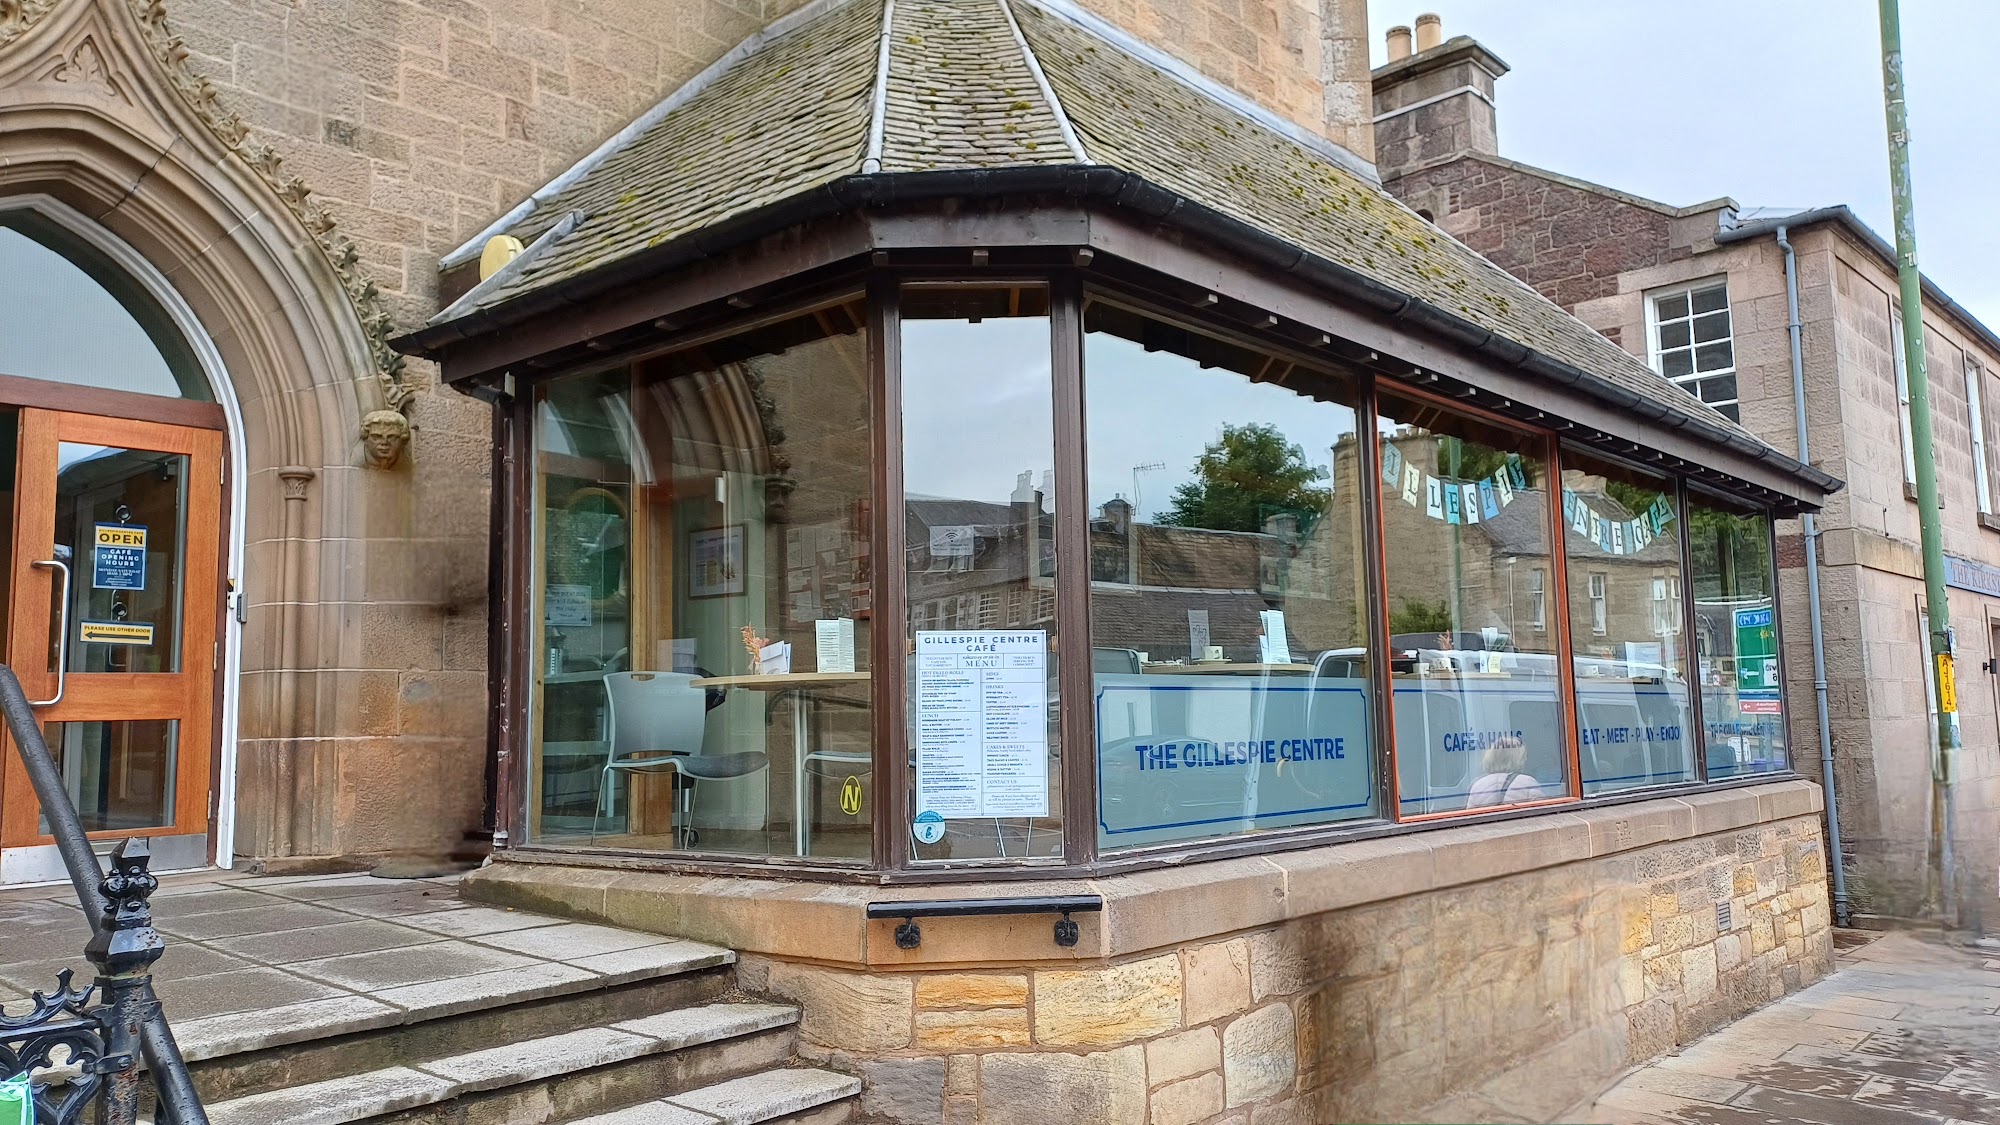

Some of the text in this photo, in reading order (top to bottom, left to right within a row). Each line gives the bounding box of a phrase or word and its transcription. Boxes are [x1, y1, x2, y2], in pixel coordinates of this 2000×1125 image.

[1387, 451, 1523, 515] ILLESPIE
[1566, 490, 1622, 547] ENTRE
[99, 533, 143, 545] OPEN
[1950, 560, 1970, 586] THE
[966, 643, 996, 652] CAFÉ
[1444, 728, 1523, 752] CAFÉ & HALLS
[1582, 725, 1683, 745] EAT MEET PLAY ENJO
[1135, 738, 1345, 770] THE GILLESPIE CENTRE
